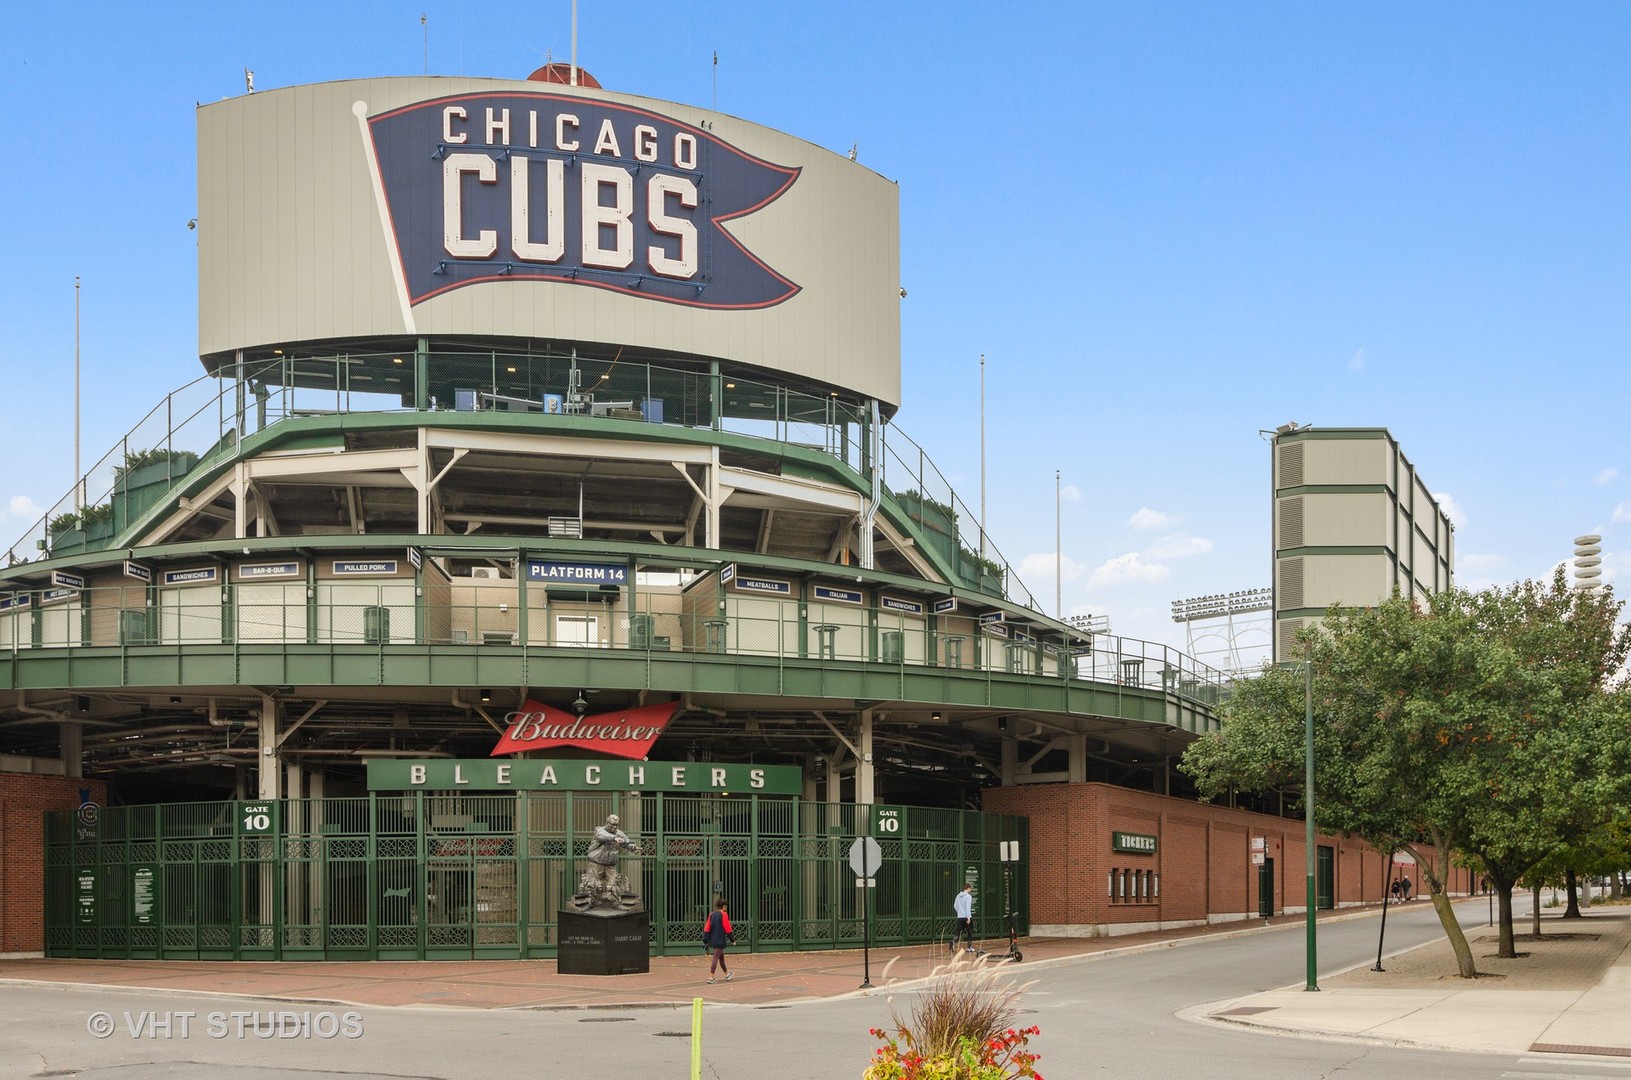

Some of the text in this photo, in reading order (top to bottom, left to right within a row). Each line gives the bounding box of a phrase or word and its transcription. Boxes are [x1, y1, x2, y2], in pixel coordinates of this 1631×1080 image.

[443, 106, 697, 170] CHICAGO
[443, 153, 698, 279] CUBS
[172, 571, 209, 581] SANDWICHES
[252, 566, 286, 574] BAR-B-QUE
[531, 565, 624, 580] PLATFORM 14
[746, 581, 779, 590] MEATBALLS
[829, 591, 848, 599] ITALIAN
[887, 600, 916, 611] SANDWICHES
[504, 711, 662, 742] Budweiser
[410, 764, 765, 788] BLEACHERS
[244, 814, 270, 830] 10
[878, 818, 899, 832] 10
[1121, 835, 1155, 849] TICKETS
